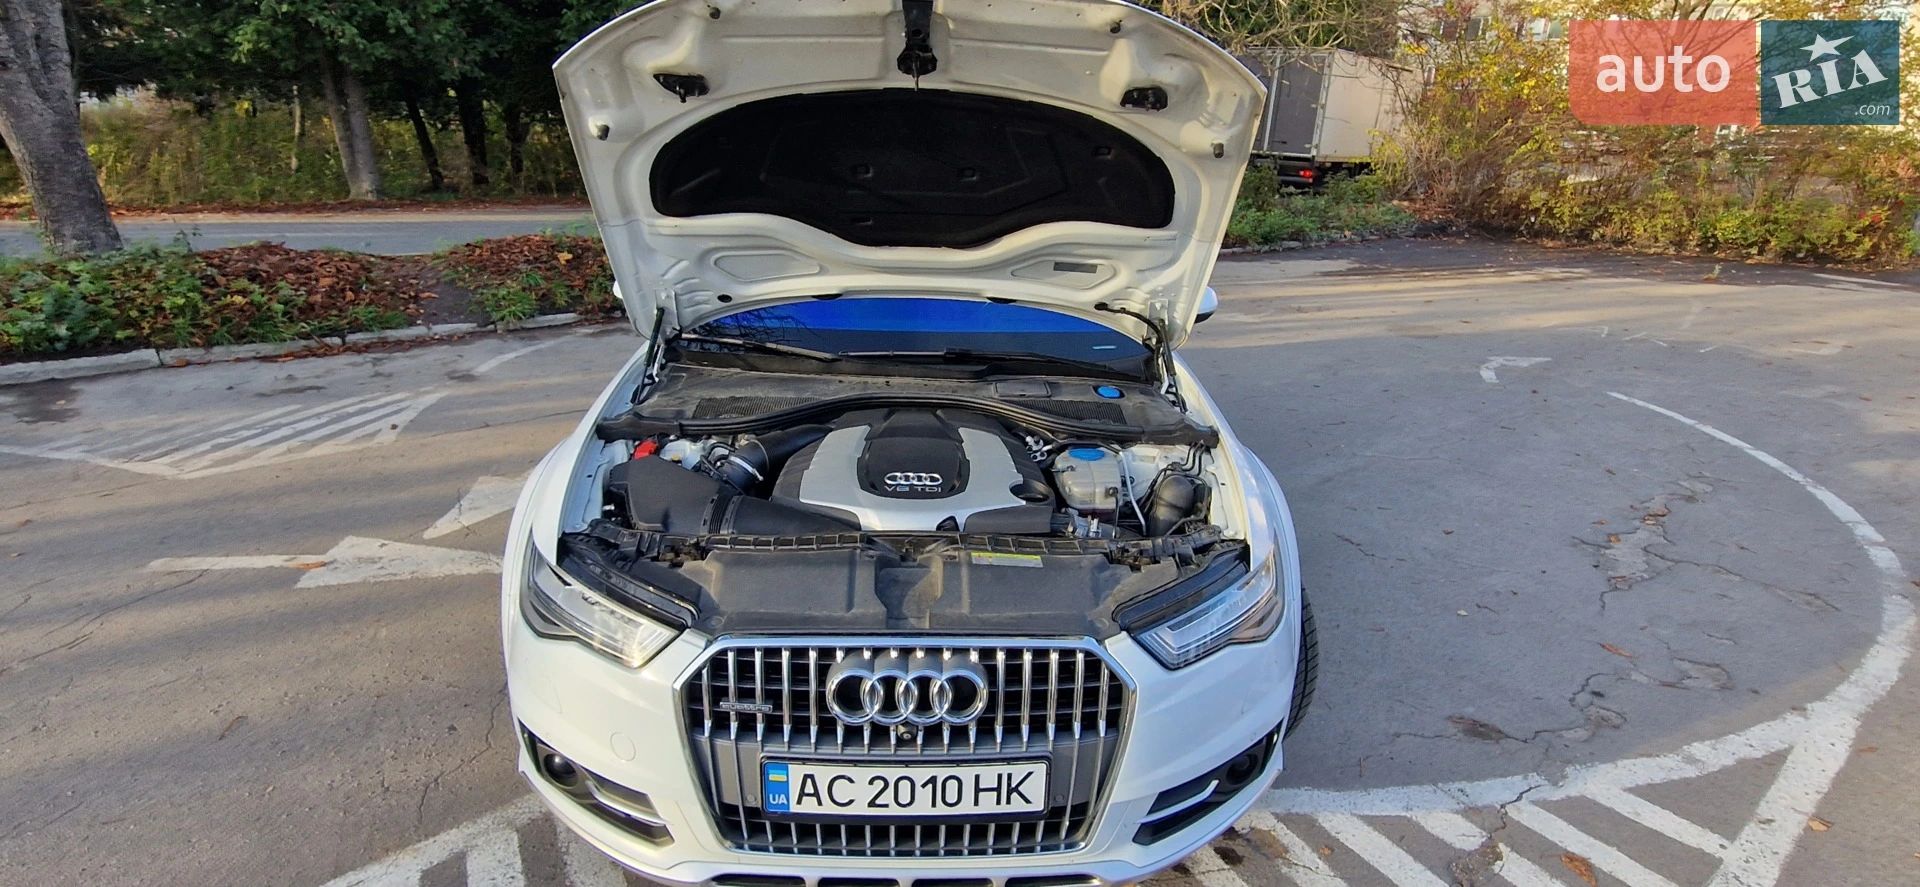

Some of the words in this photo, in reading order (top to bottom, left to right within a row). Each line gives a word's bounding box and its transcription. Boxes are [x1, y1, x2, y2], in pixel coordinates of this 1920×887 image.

[769, 793, 788, 805] UA
[796, 773, 856, 808] AC
[867, 775, 964, 808] 2010
[973, 771, 1035, 807] HK
